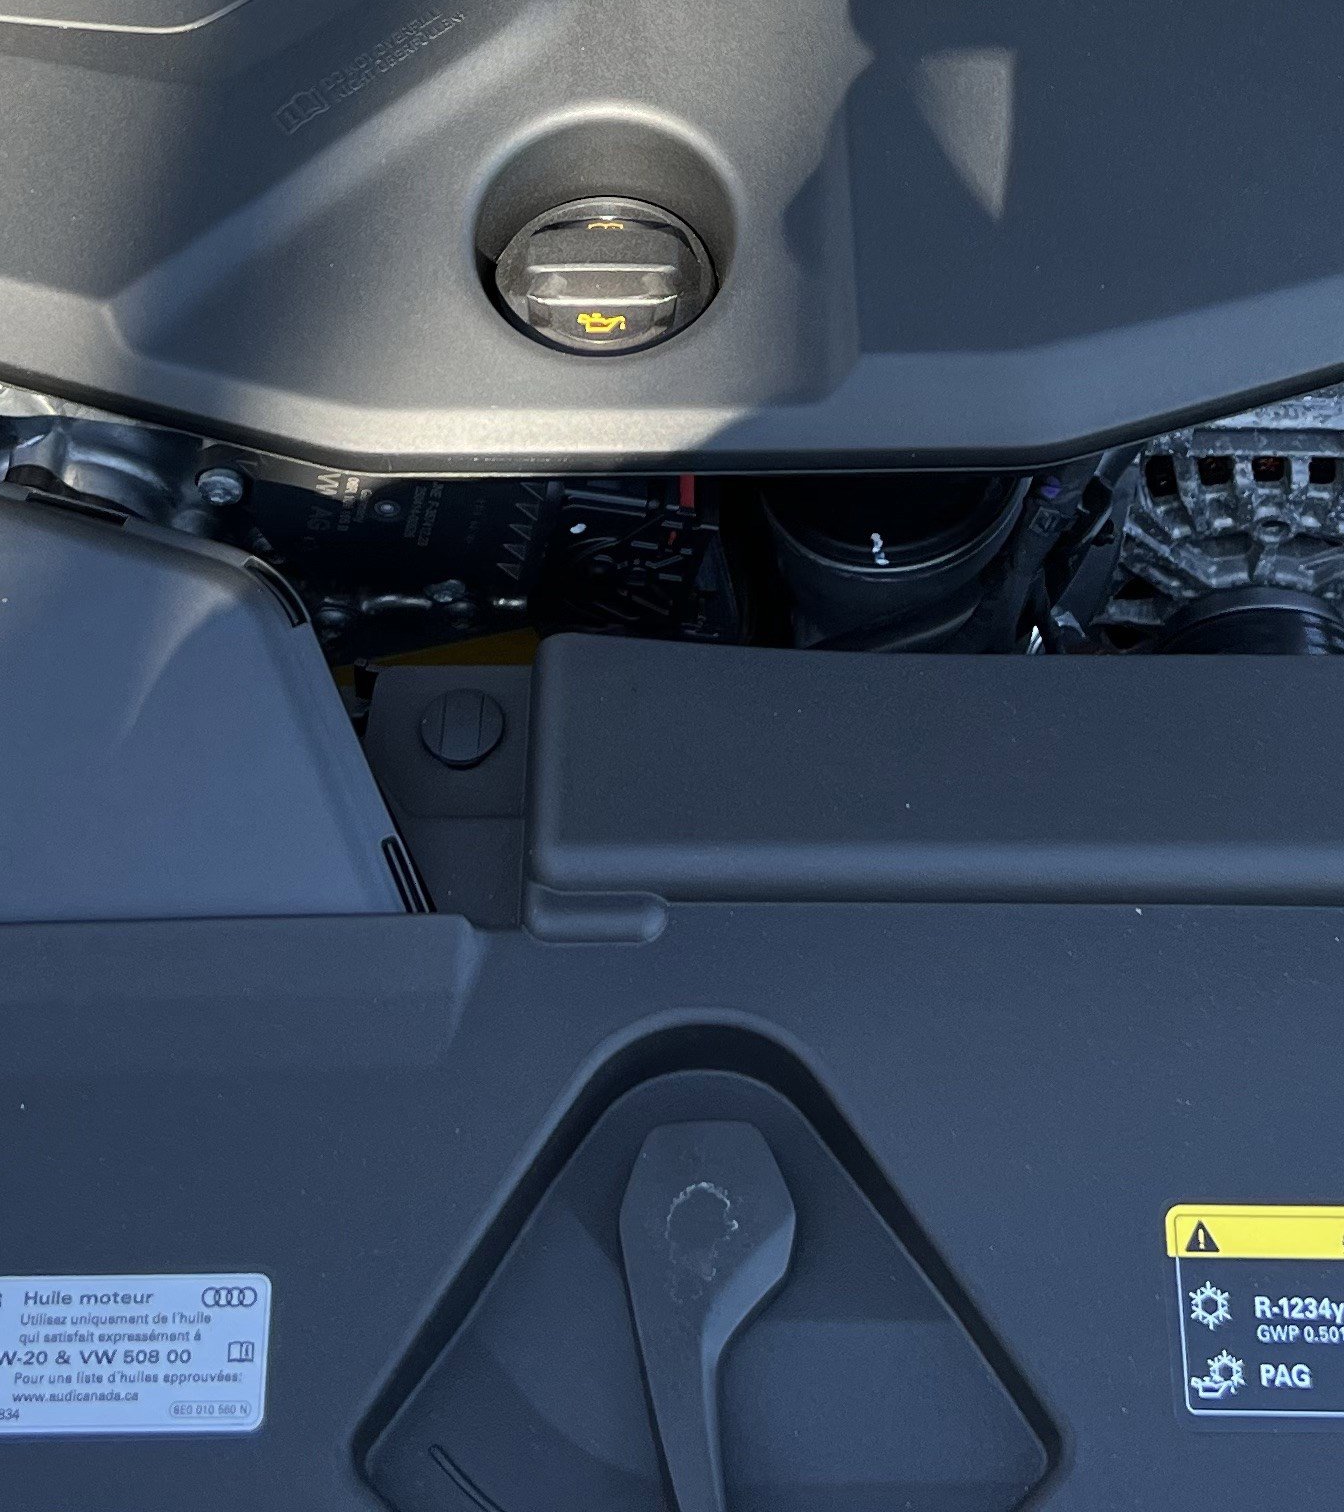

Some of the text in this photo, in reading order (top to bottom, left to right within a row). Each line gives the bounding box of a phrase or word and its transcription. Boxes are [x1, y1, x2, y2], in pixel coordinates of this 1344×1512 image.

[24, 1291, 154, 1306] Huile moteur
[20, 1313, 67, 1326] Utilisez
[71, 1313, 149, 1327] uniquement
[152, 1312, 168, 1324] de
[19, 1331, 40, 1345] qui
[44, 1330, 94, 1343] satisfait
[98, 1330, 190, 1345] expressément
[1257, 1325, 1300, 1344] GWP
[55, 1350, 71, 1365] &
[80, 1349, 117, 1365] VW
[123, 1349, 160, 1365] 508
[166, 1349, 192, 1364] 00
[14, 1372, 45, 1385] Pour
[48, 1375, 72, 1384] une
[76, 1372, 103, 1384] liste
[1261, 1364, 1311, 1388] PAG
[12, 1389, 139, 1402] www.audicanada.ca
